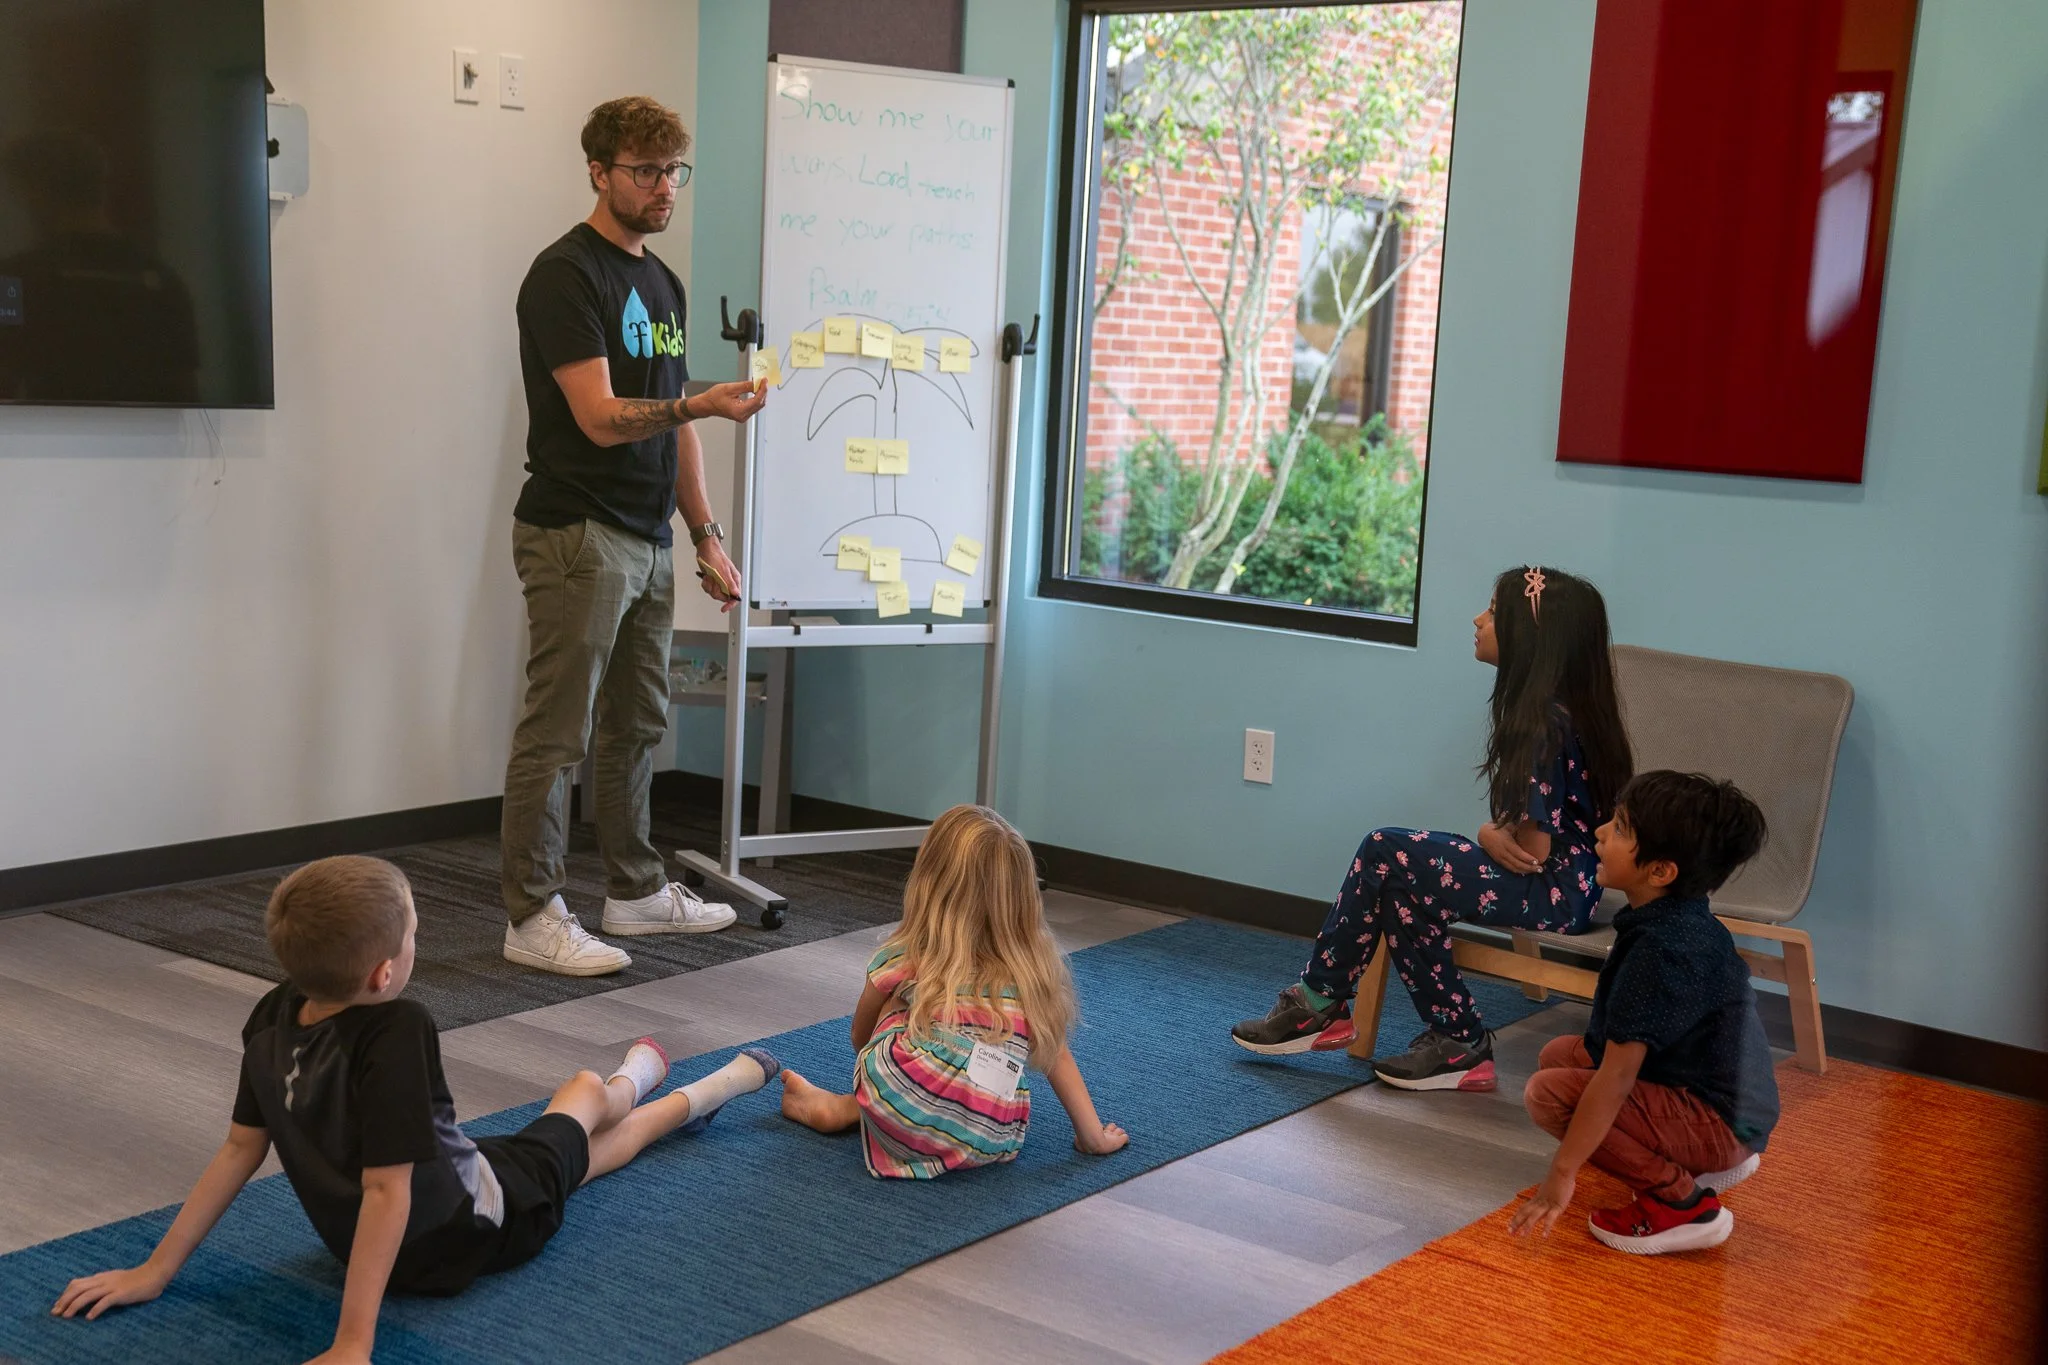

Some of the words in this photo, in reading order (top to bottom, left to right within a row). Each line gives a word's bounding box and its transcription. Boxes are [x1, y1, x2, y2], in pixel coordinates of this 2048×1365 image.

[780, 85, 863, 127] Show
[879, 107, 926, 130] me
[943, 113, 999, 143] your
[917, 179, 976, 203] teach
[780, 213, 818, 237] me
[838, 217, 896, 246] your
[808, 266, 879, 311] Psalm
[651, 311, 684, 357] Kids
[978, 1048, 1002, 1063] Caroline
